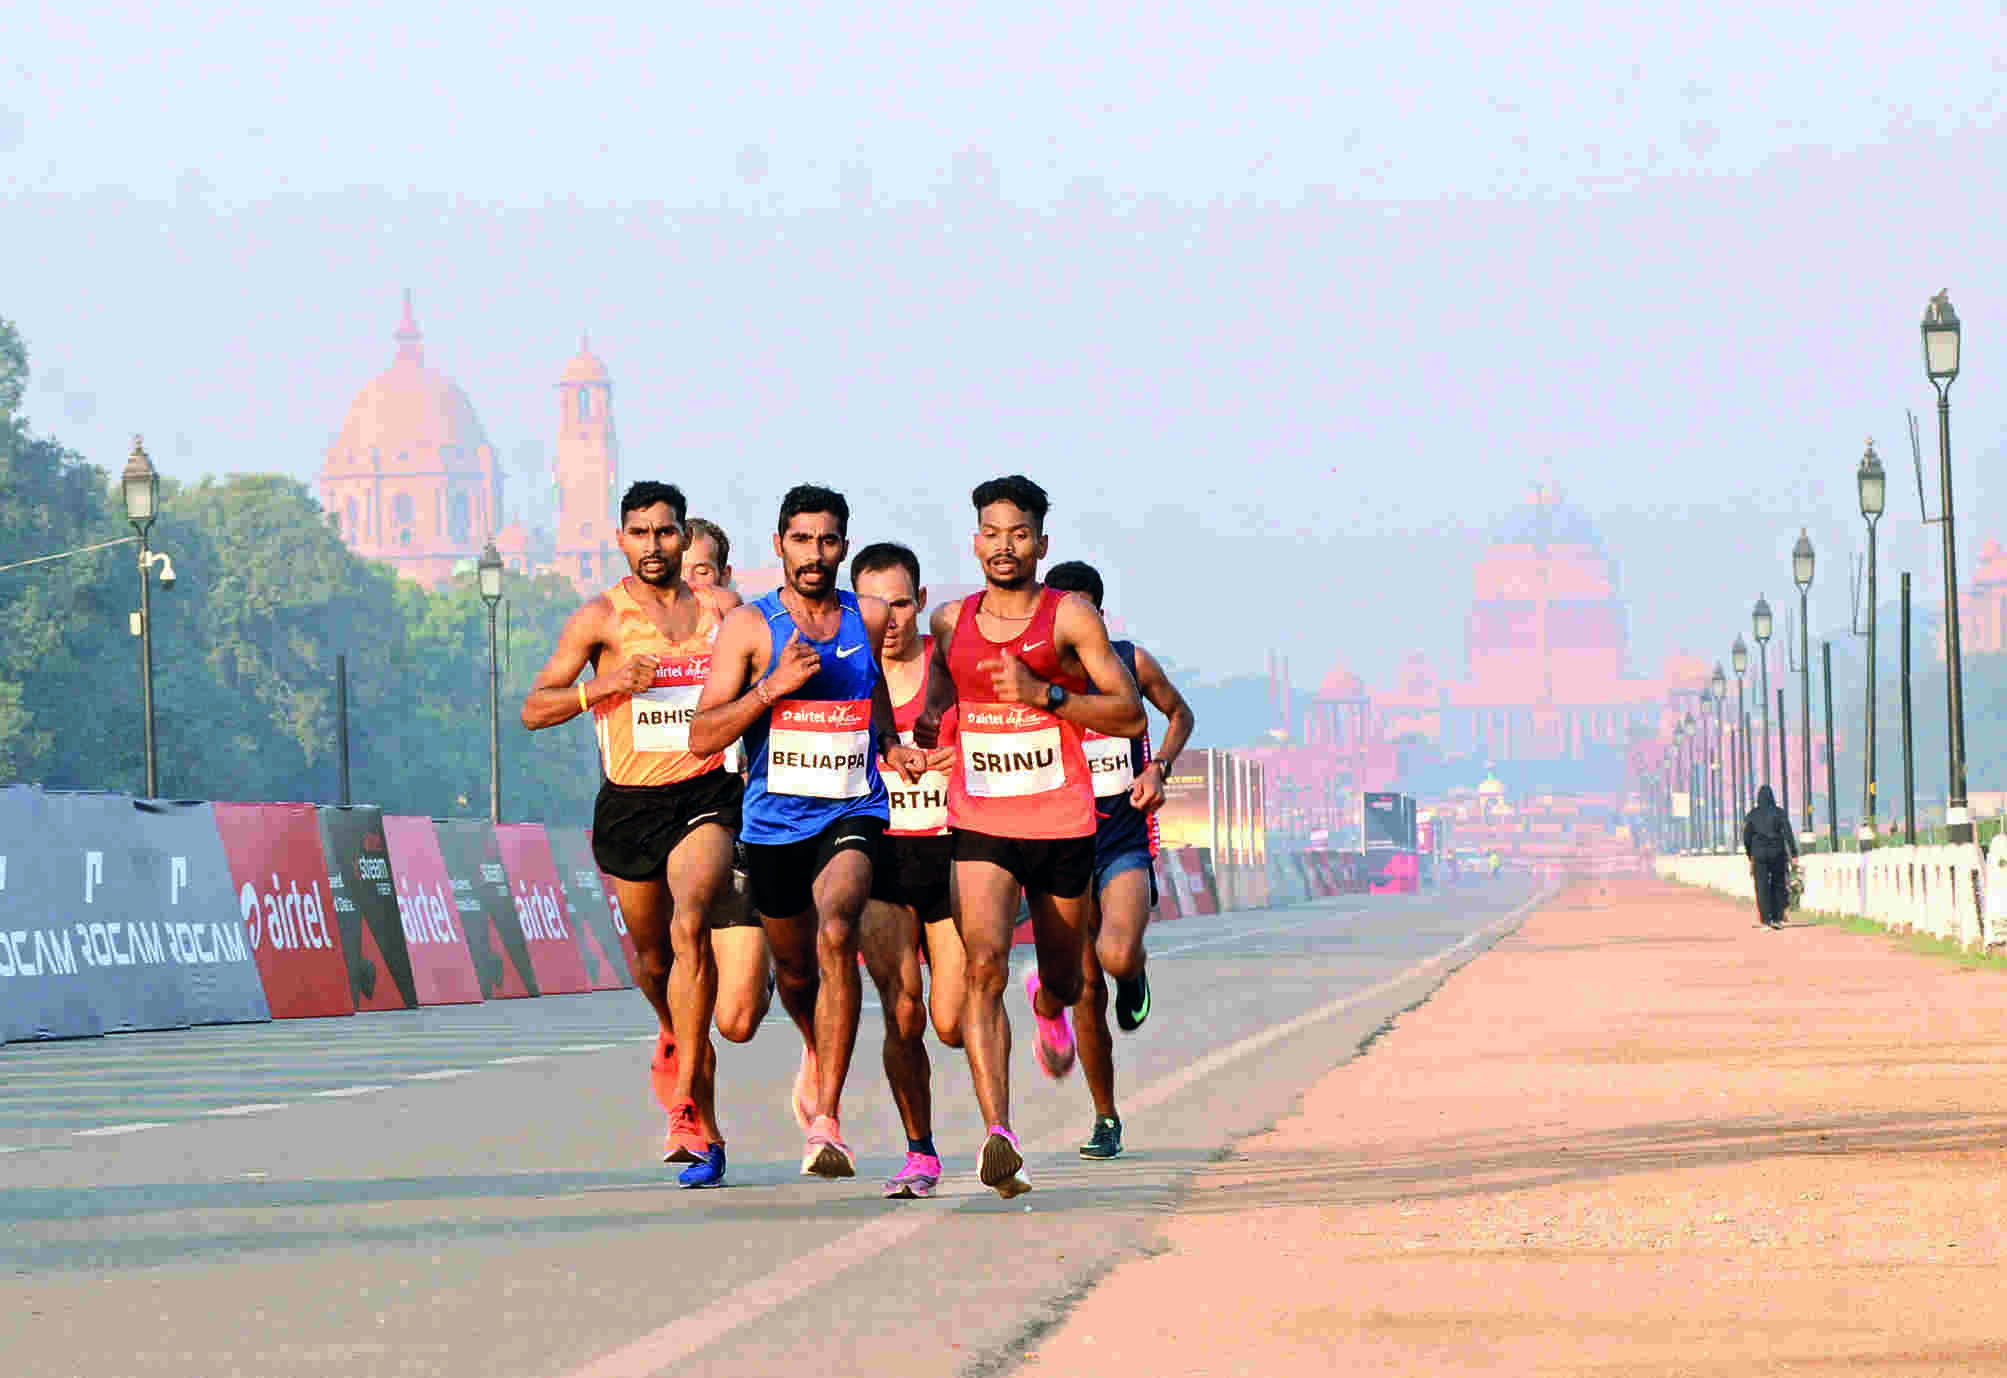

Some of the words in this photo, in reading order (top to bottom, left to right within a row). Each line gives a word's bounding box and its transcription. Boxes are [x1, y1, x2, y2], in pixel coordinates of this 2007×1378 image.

[793, 708, 825, 723] airtel
[975, 711, 1003, 725] airtel
[772, 751, 865, 771] BELIAPPA
[971, 747, 1053, 773] SRINU
[263, 872, 333, 950] airtel
[396, 875, 458, 944] airtel
[510, 880, 569, 941] airtel
